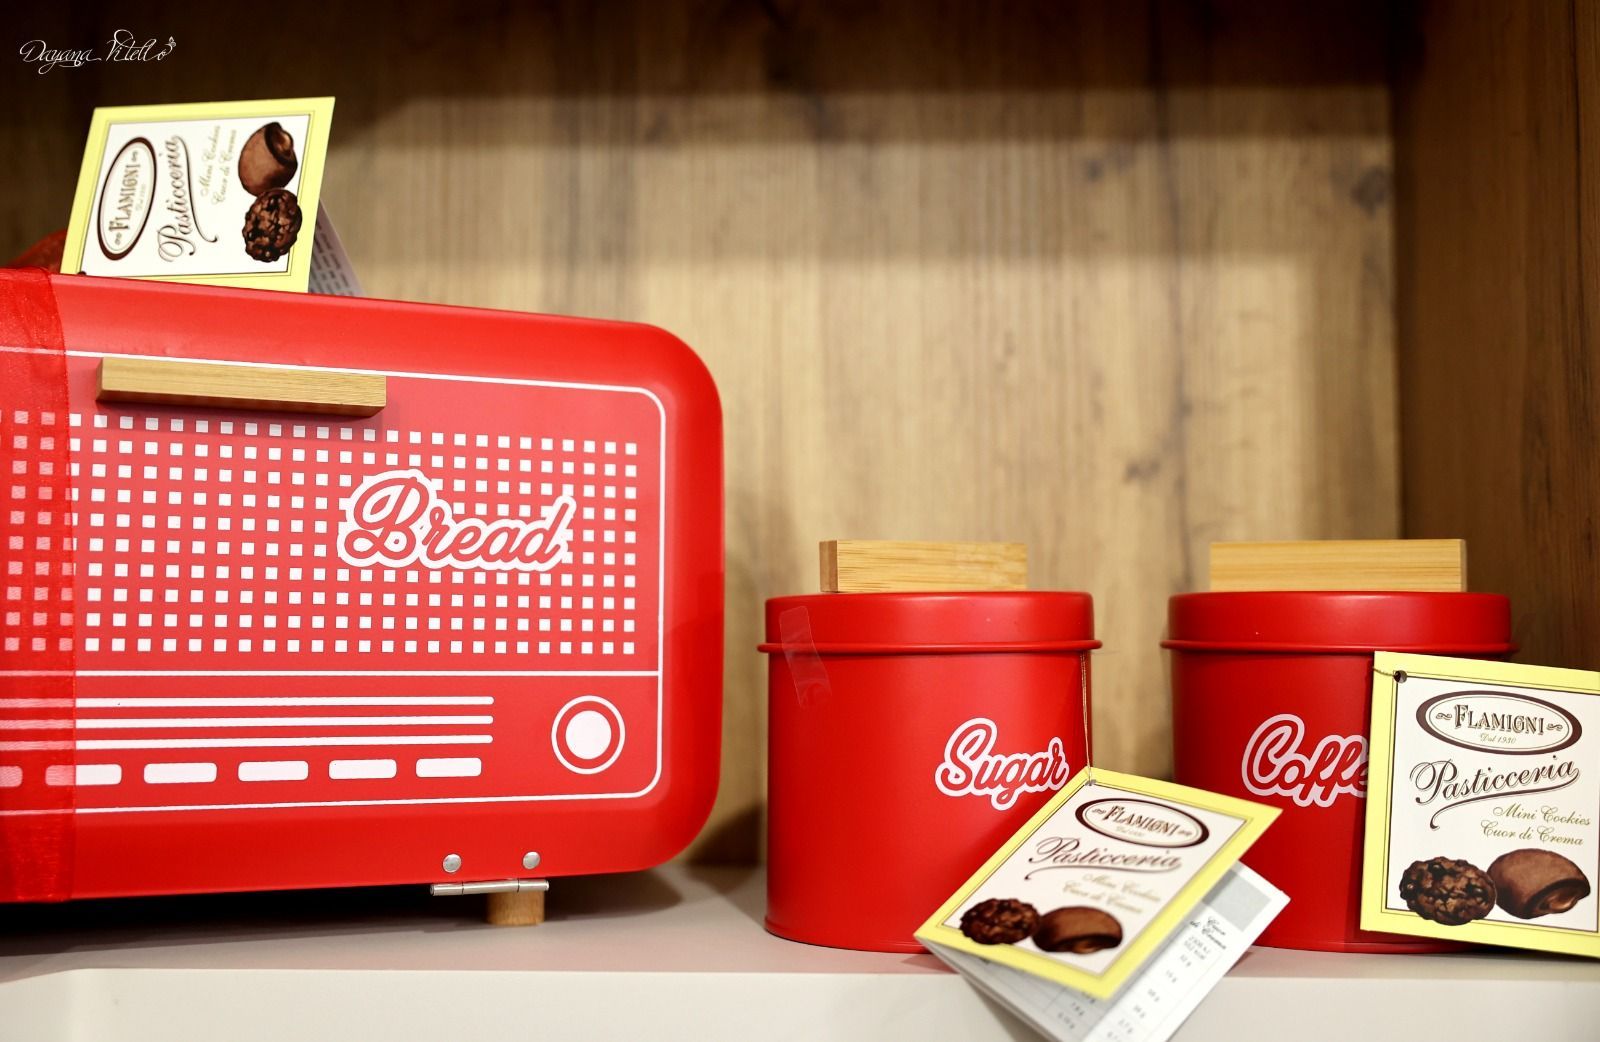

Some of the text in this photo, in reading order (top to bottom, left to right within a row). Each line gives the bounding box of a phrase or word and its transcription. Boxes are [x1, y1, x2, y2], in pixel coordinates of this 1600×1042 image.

[108, 163, 141, 232] FLAMIGNI
[157, 135, 217, 262] Pasticceria
[337, 468, 576, 571] Bread
[1454, 704, 1545, 736] FLAMIGNI
[1479, 732, 1496, 744] Dal
[934, 717, 1070, 811] Sugar
[1409, 754, 1580, 831] Pasticceria
[1493, 803, 1591, 826] Mini Cookies
[1103, 805, 1180, 837] FLAMIGNI
[1480, 820, 1584, 846] Cuor di Crema
[1024, 836, 1183, 881] Pasticceria
